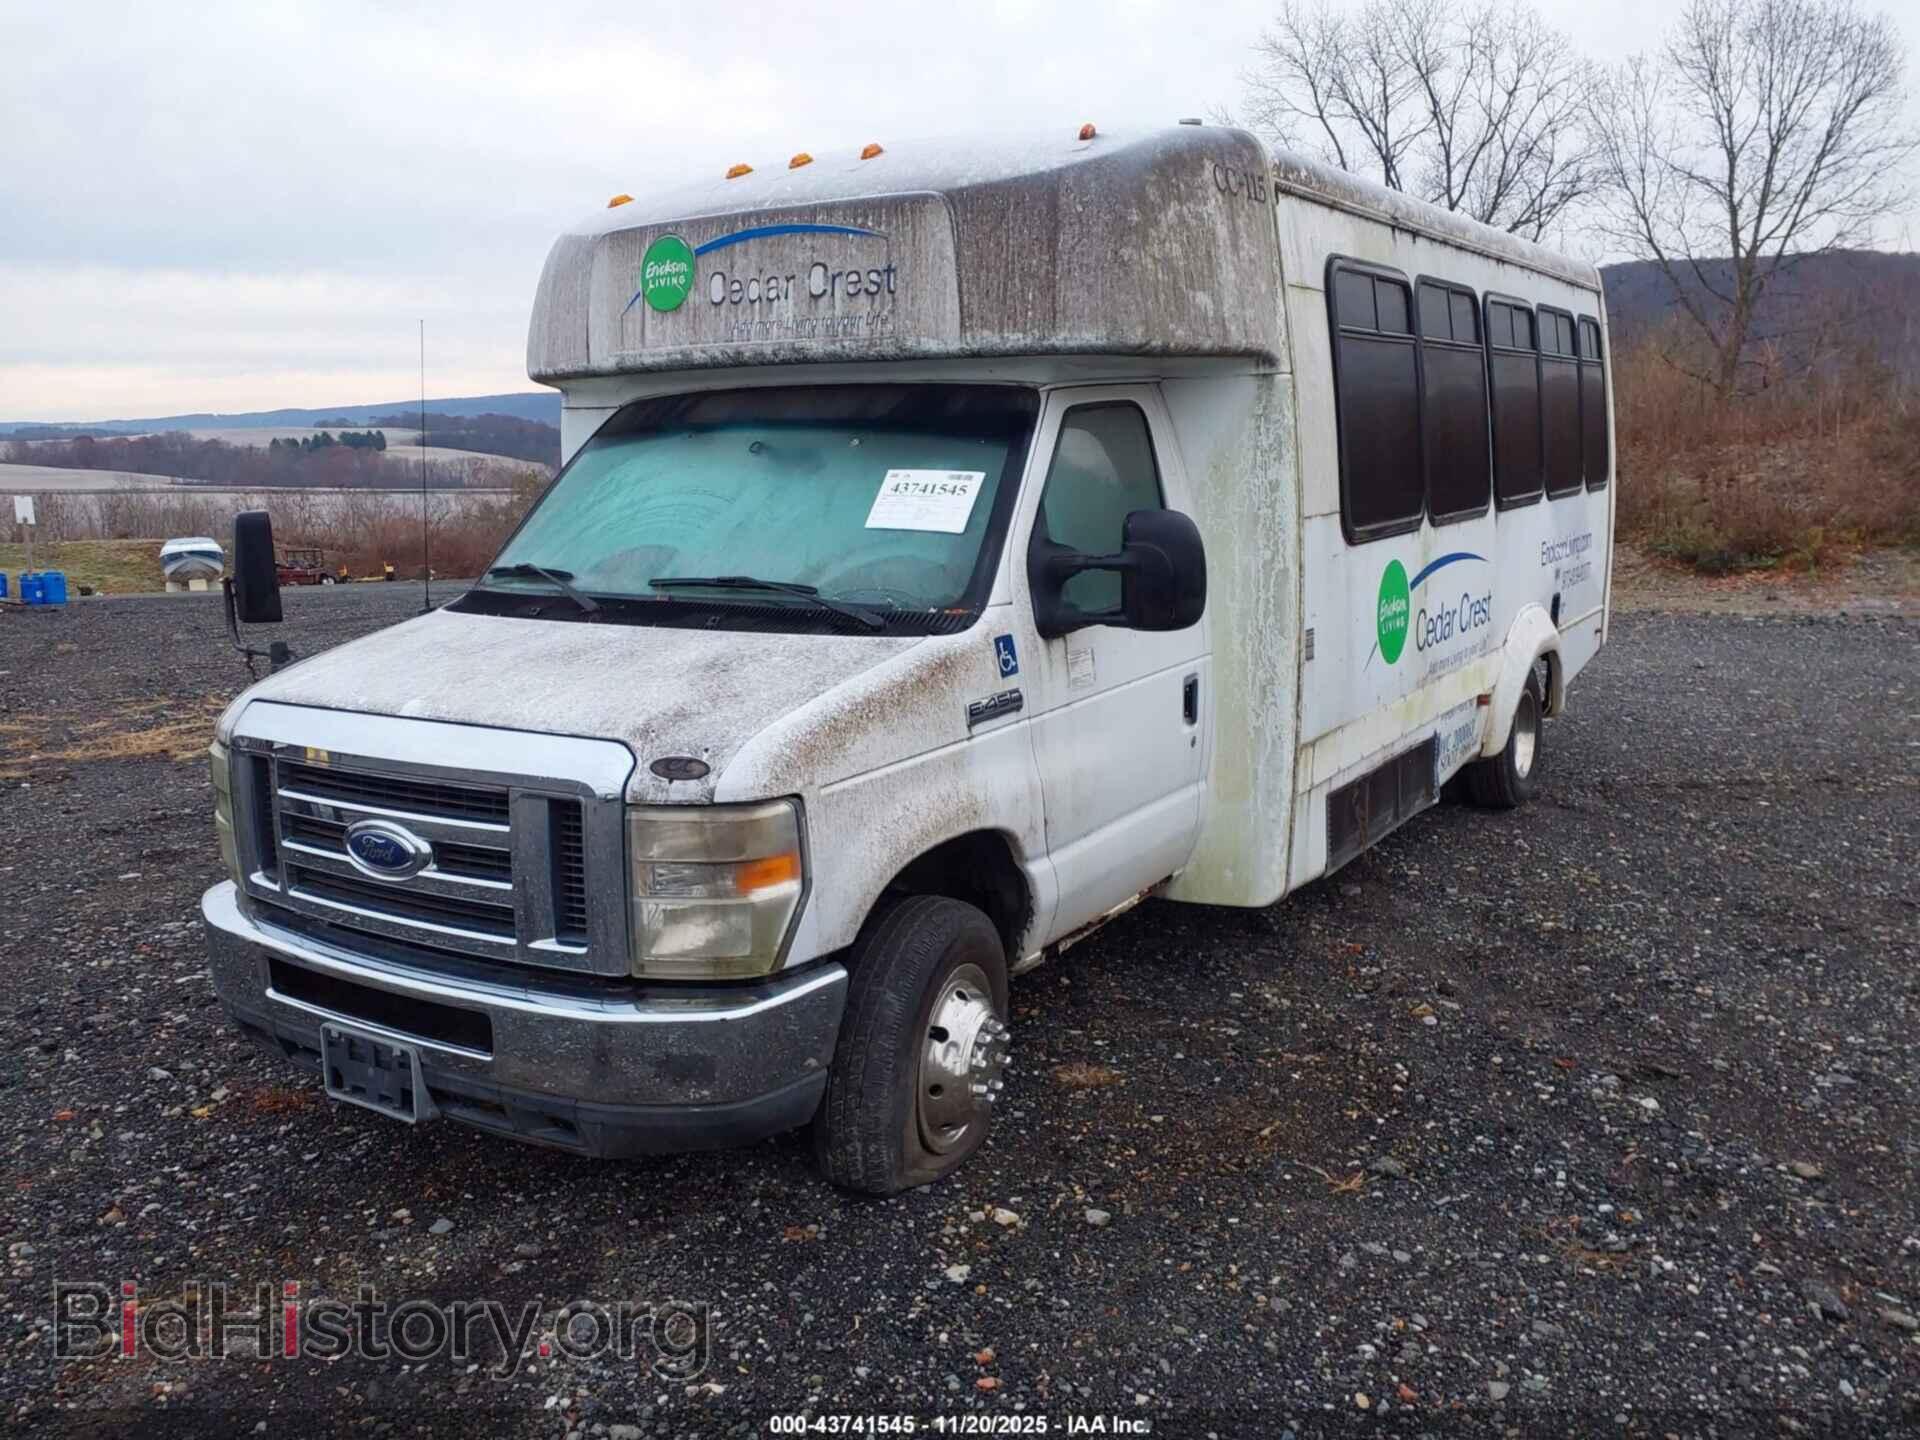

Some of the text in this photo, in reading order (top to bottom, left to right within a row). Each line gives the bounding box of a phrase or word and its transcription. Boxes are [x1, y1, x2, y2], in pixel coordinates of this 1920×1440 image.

[645, 259, 689, 279] Erickson
[648, 275, 688, 292] LIVING
[710, 261, 896, 306] Cedar Crest
[890, 482, 969, 496] 43741545
[1416, 591, 1492, 652] Cedar Crest
[361, 835, 394, 862] Ford
